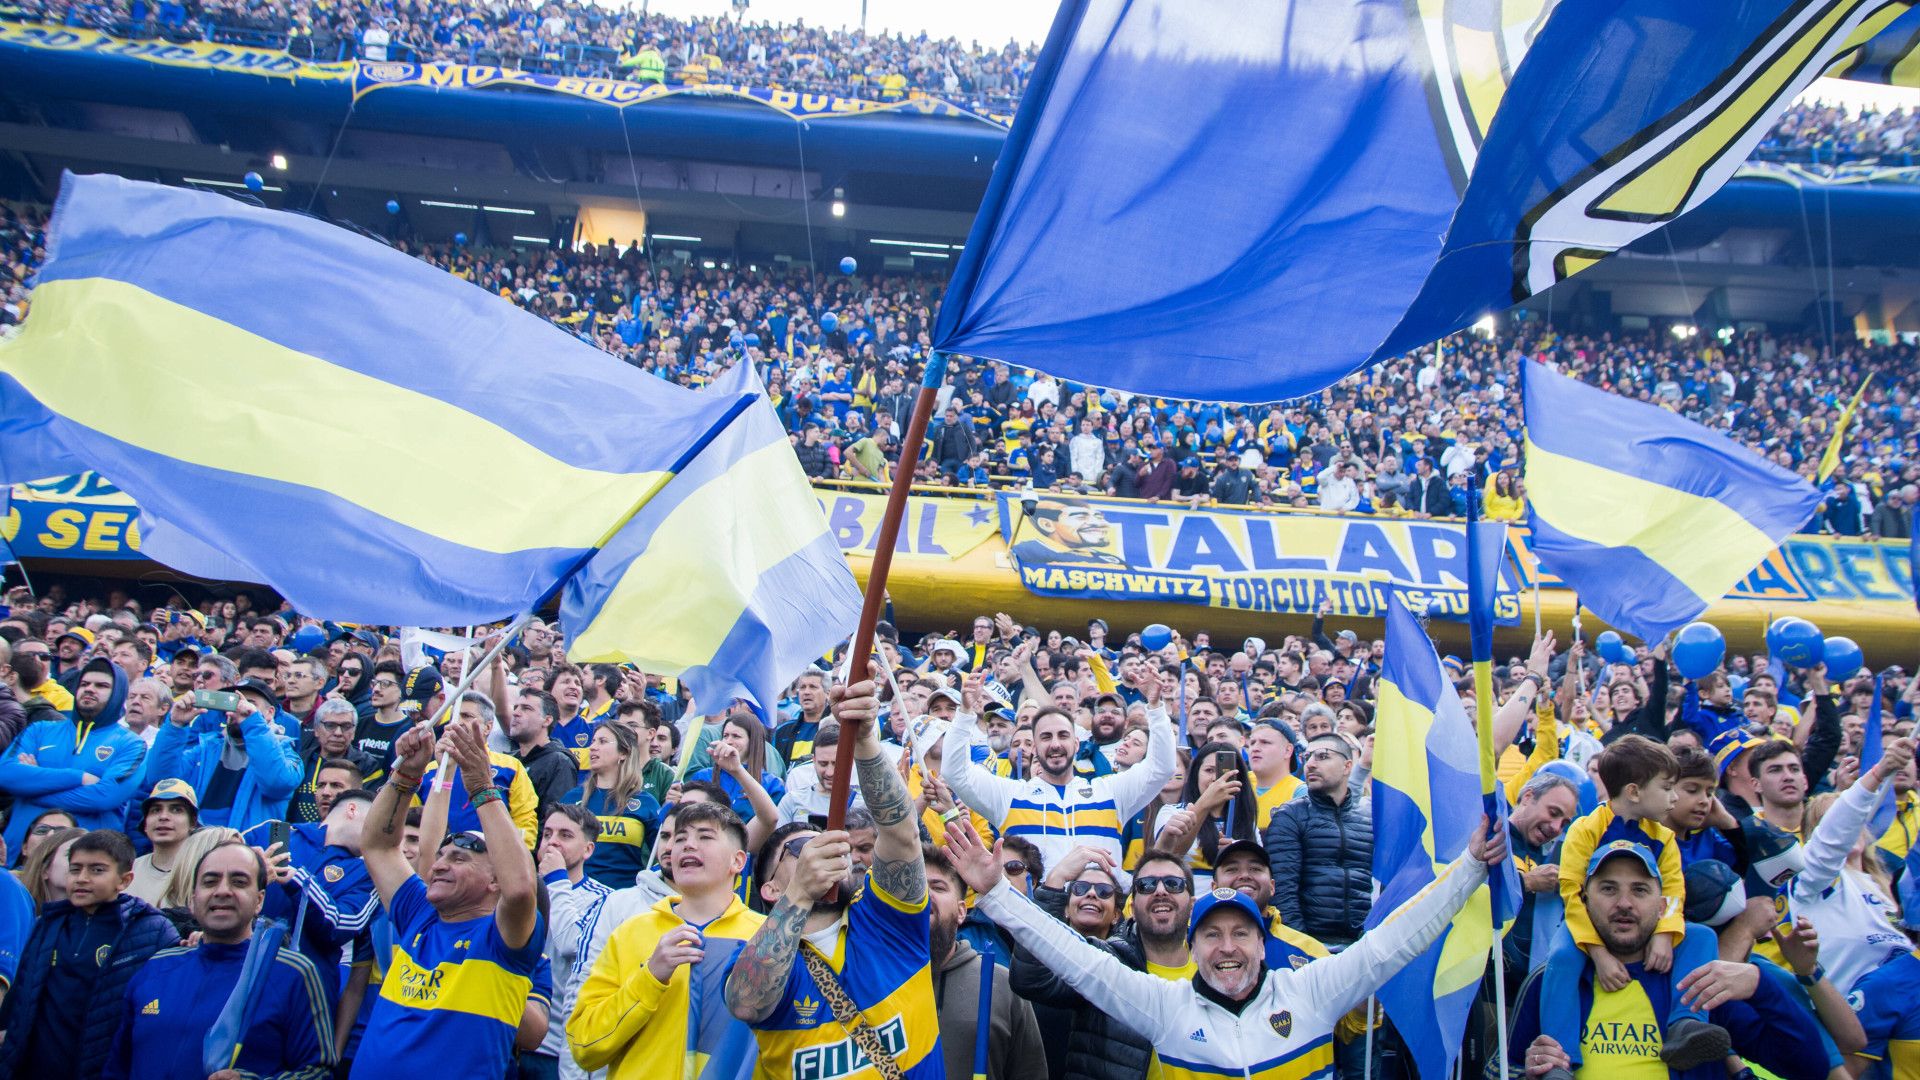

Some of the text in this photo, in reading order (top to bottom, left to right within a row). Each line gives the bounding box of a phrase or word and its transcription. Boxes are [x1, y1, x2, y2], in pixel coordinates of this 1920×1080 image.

[1022, 565, 1207, 598] MASCHWITZ
[1212, 576, 1372, 617] TORCUATO
[1589, 1042, 1659, 1058] AIRWAYS
